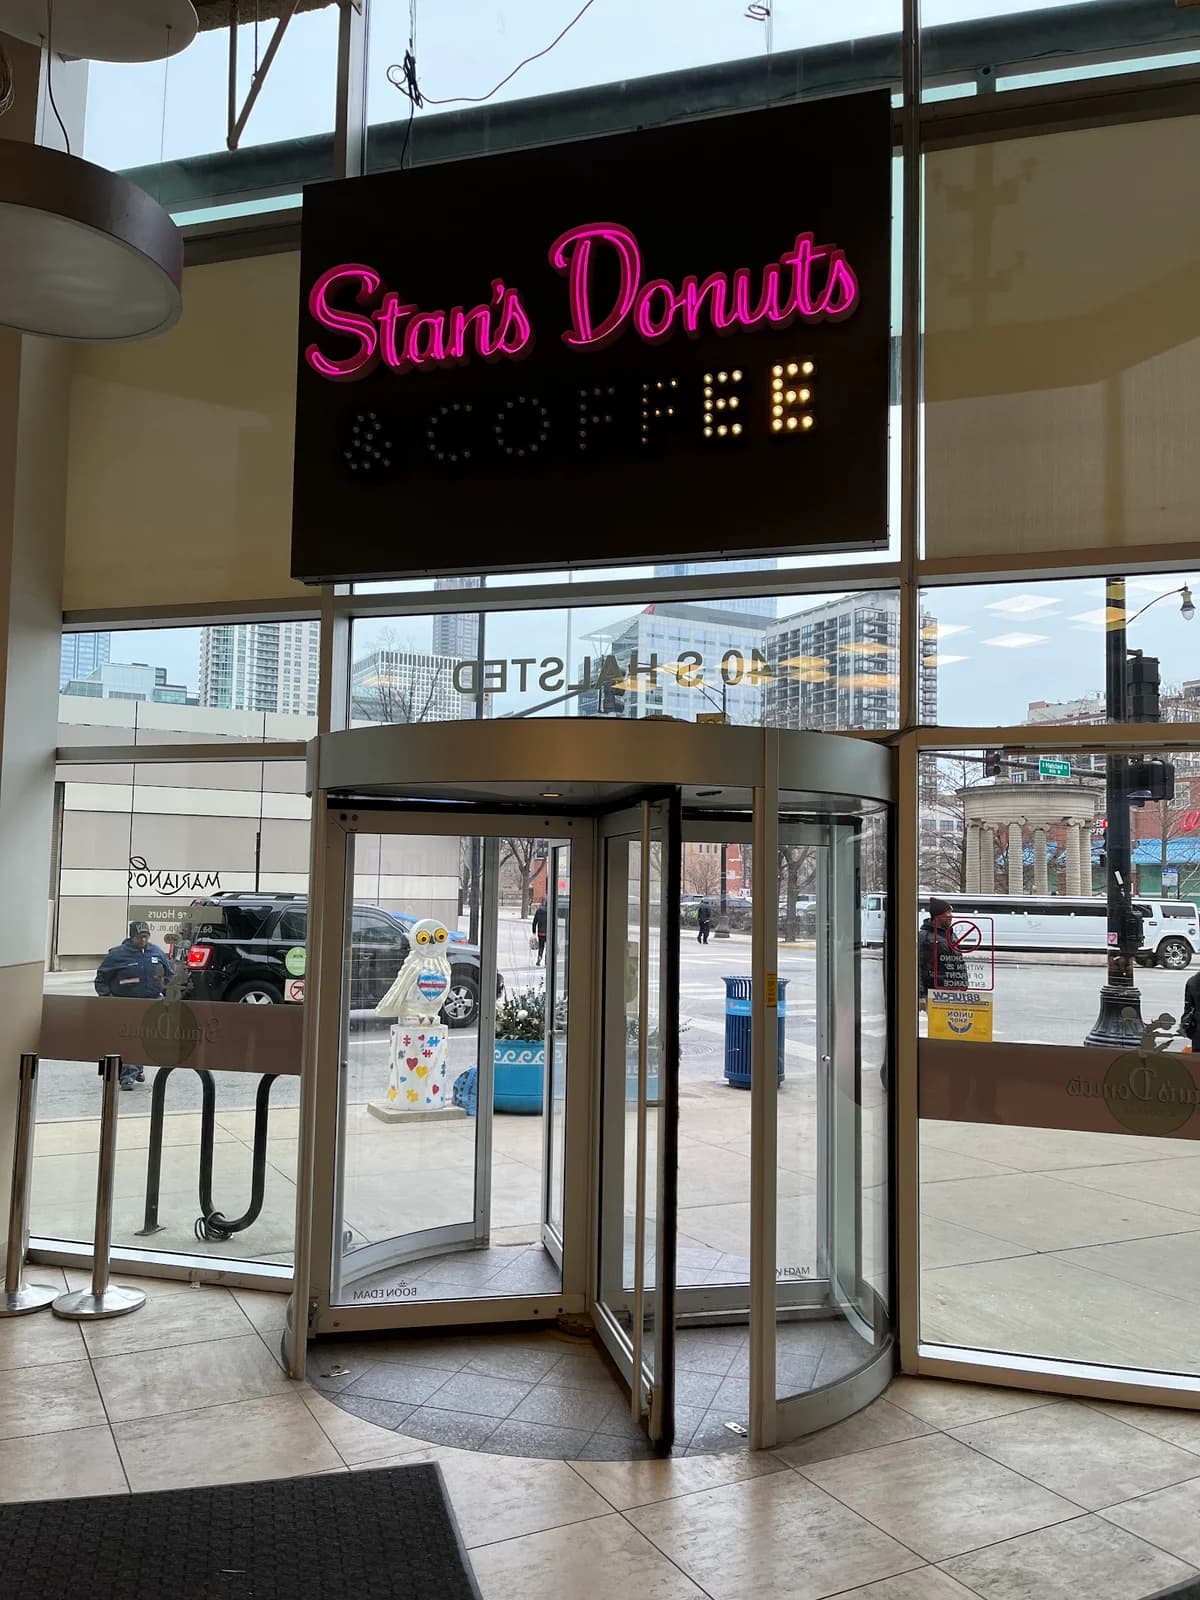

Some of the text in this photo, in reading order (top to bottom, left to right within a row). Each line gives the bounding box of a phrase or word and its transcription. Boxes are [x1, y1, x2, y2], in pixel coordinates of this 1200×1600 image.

[305, 222, 861, 382] Stan's Donuts
[344, 360, 816, 470] & COFFEE
[783, 1265, 810, 1276] EDAM
